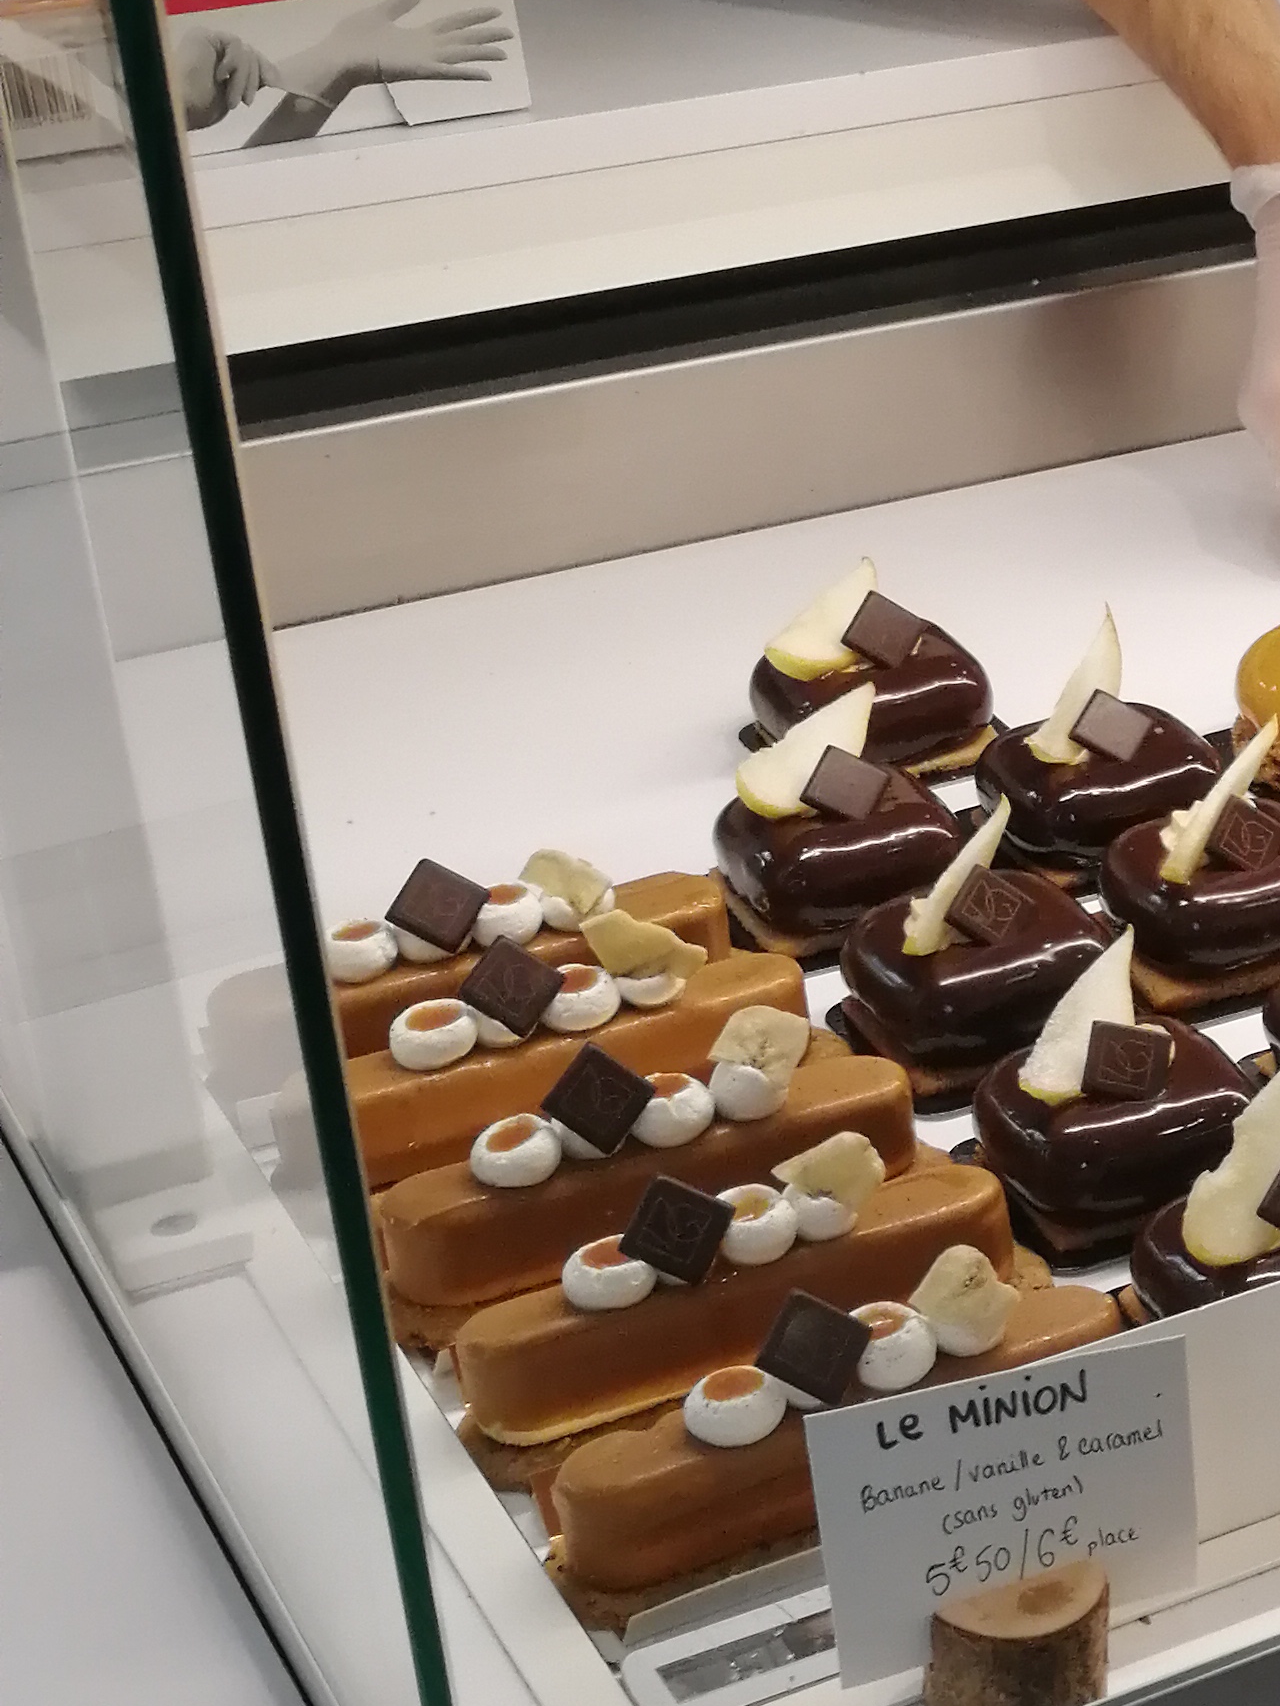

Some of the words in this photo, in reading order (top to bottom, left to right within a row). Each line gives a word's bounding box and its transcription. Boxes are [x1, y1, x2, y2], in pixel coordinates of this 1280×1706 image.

[1077, 1419, 1165, 1456] caramel
[941, 1504, 999, 1535] (sans
[1013, 1474, 1085, 1522] gluten)
[1087, 1527, 1142, 1558] place
